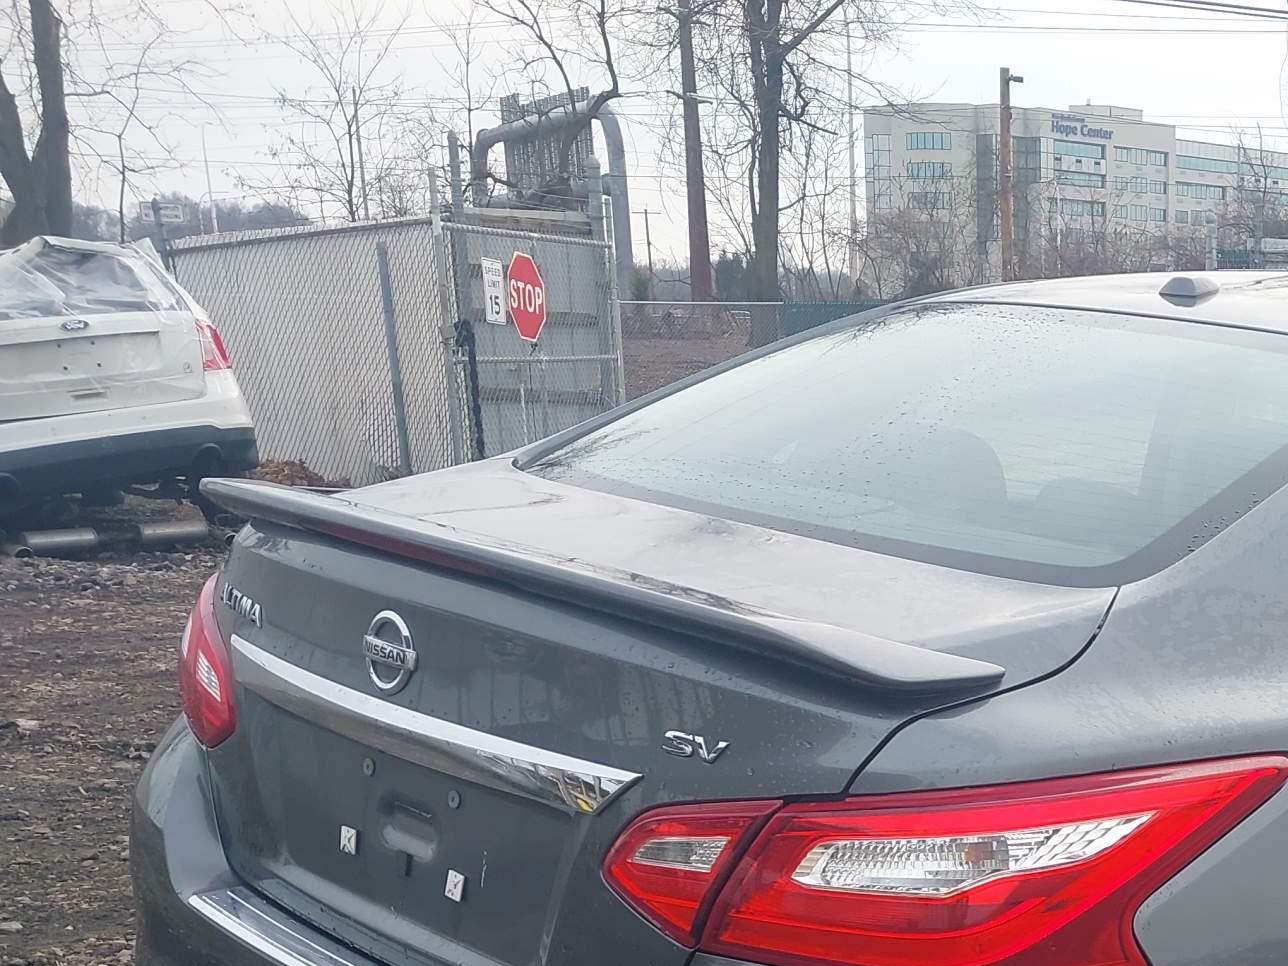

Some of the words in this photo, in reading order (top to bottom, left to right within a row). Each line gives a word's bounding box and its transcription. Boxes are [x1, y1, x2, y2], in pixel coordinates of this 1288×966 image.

[1051, 119, 1078, 137] Hope
[1080, 124, 1114, 139] Center
[484, 265, 502, 277] SPEED
[487, 279, 501, 289] LIMIT
[489, 294, 501, 316] 15
[510, 278, 543, 314] STOP
[363, 637, 406, 665] NISSAN
[661, 730, 730, 765] SV
